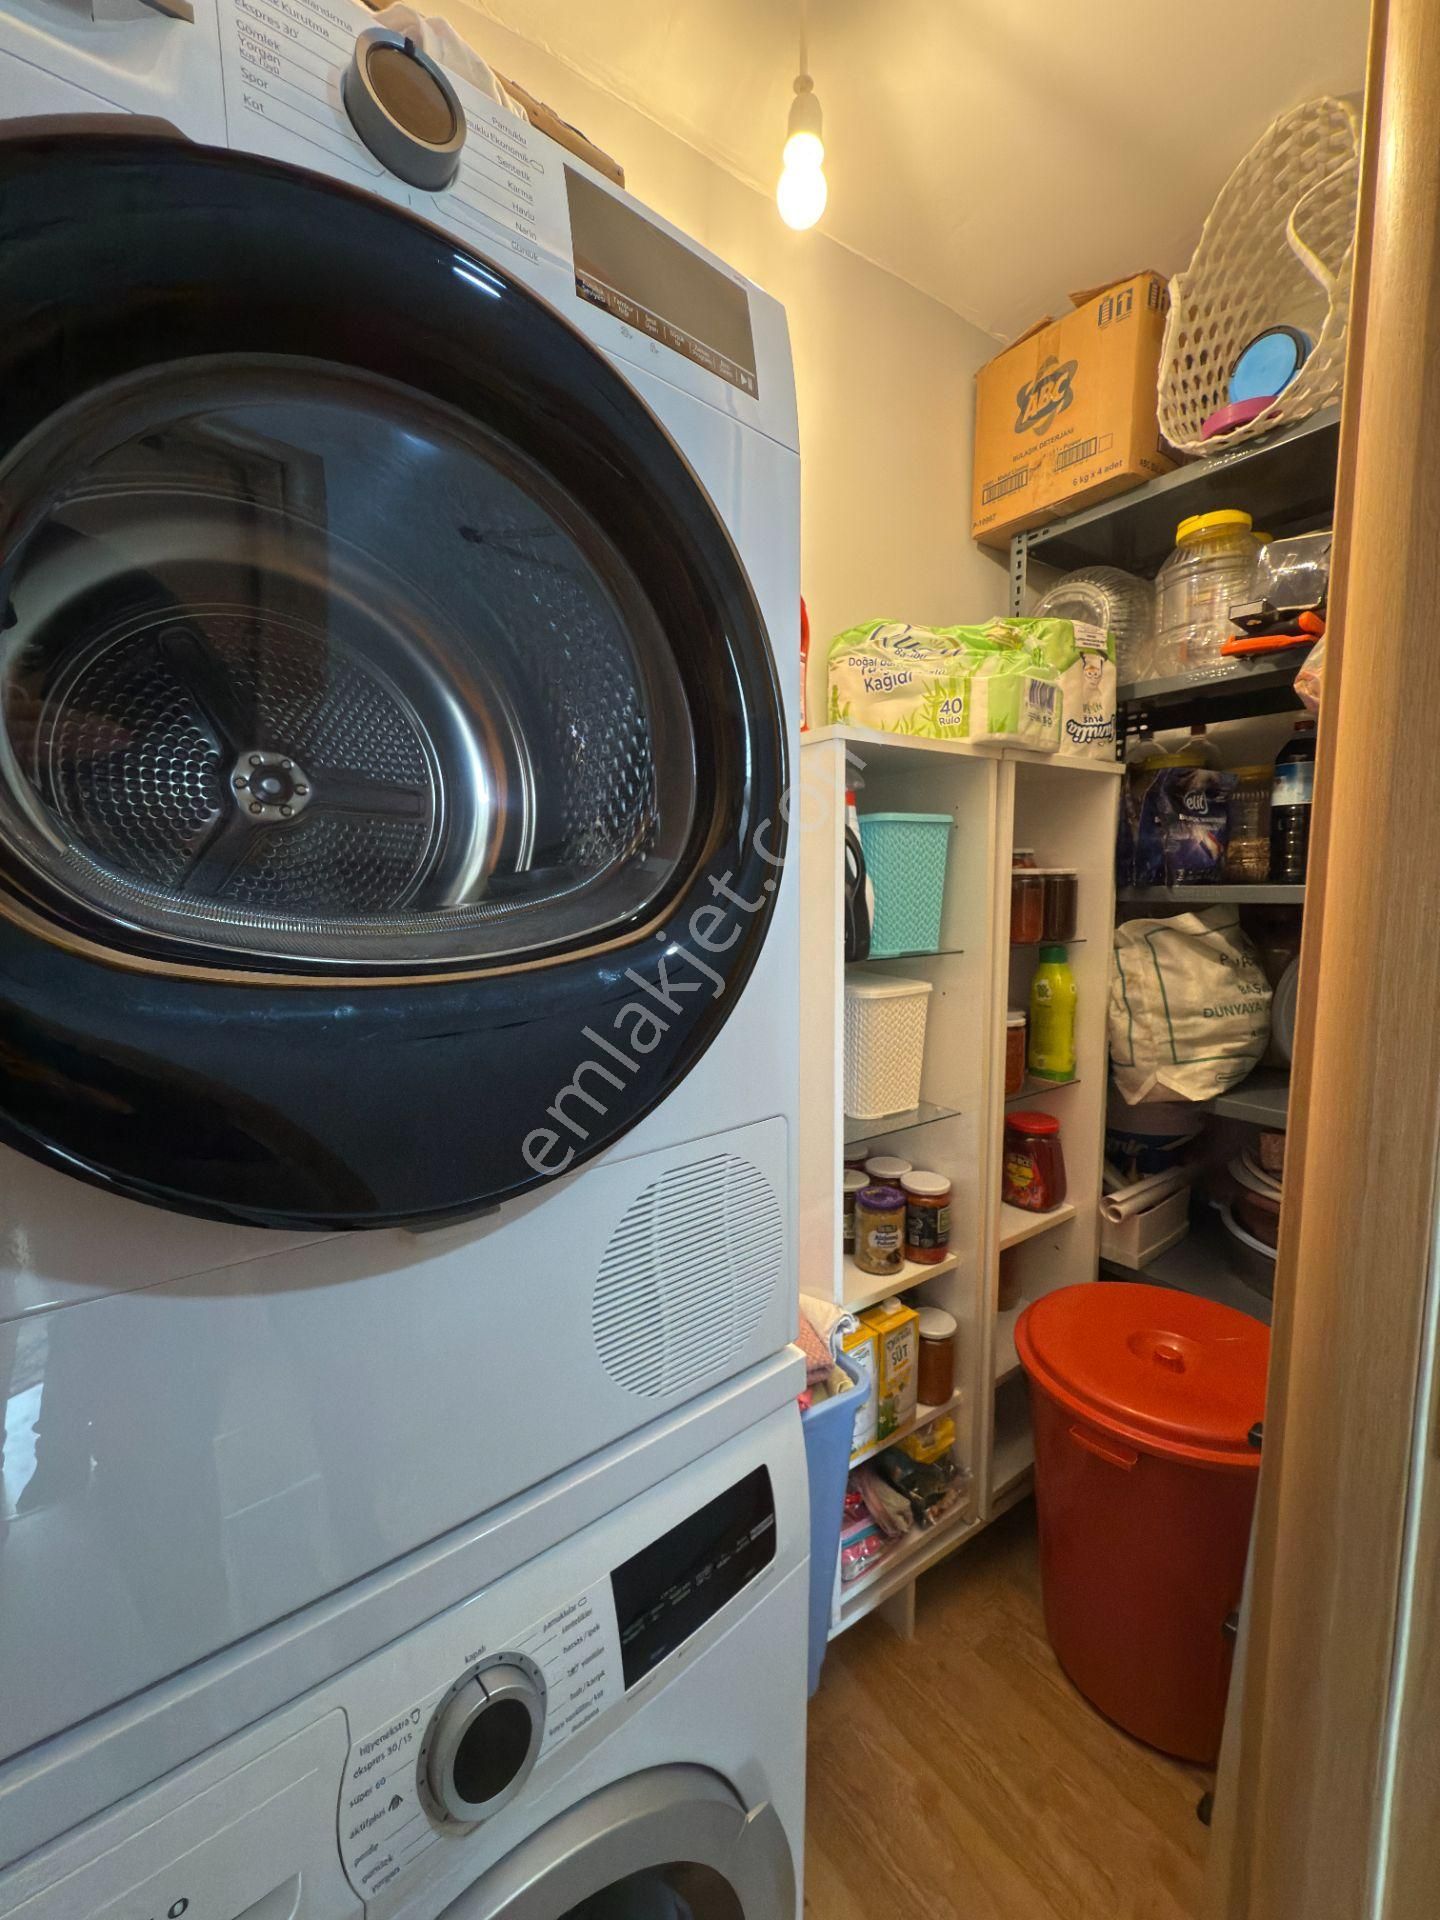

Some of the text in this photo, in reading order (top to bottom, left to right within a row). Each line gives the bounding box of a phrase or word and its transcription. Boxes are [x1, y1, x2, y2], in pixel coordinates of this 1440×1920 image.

[240, 67, 269, 89] Spor
[243, 93, 266, 114] Kot
[1072, 476, 1079, 487] 6
[1079, 470, 1090, 485] kg
[1097, 464, 1103, 476] 4
[1103, 458, 1124, 474] adet
[848, 656, 877, 668] Doğal
[939, 697, 963, 716] 40
[938, 715, 961, 726] Rulo
